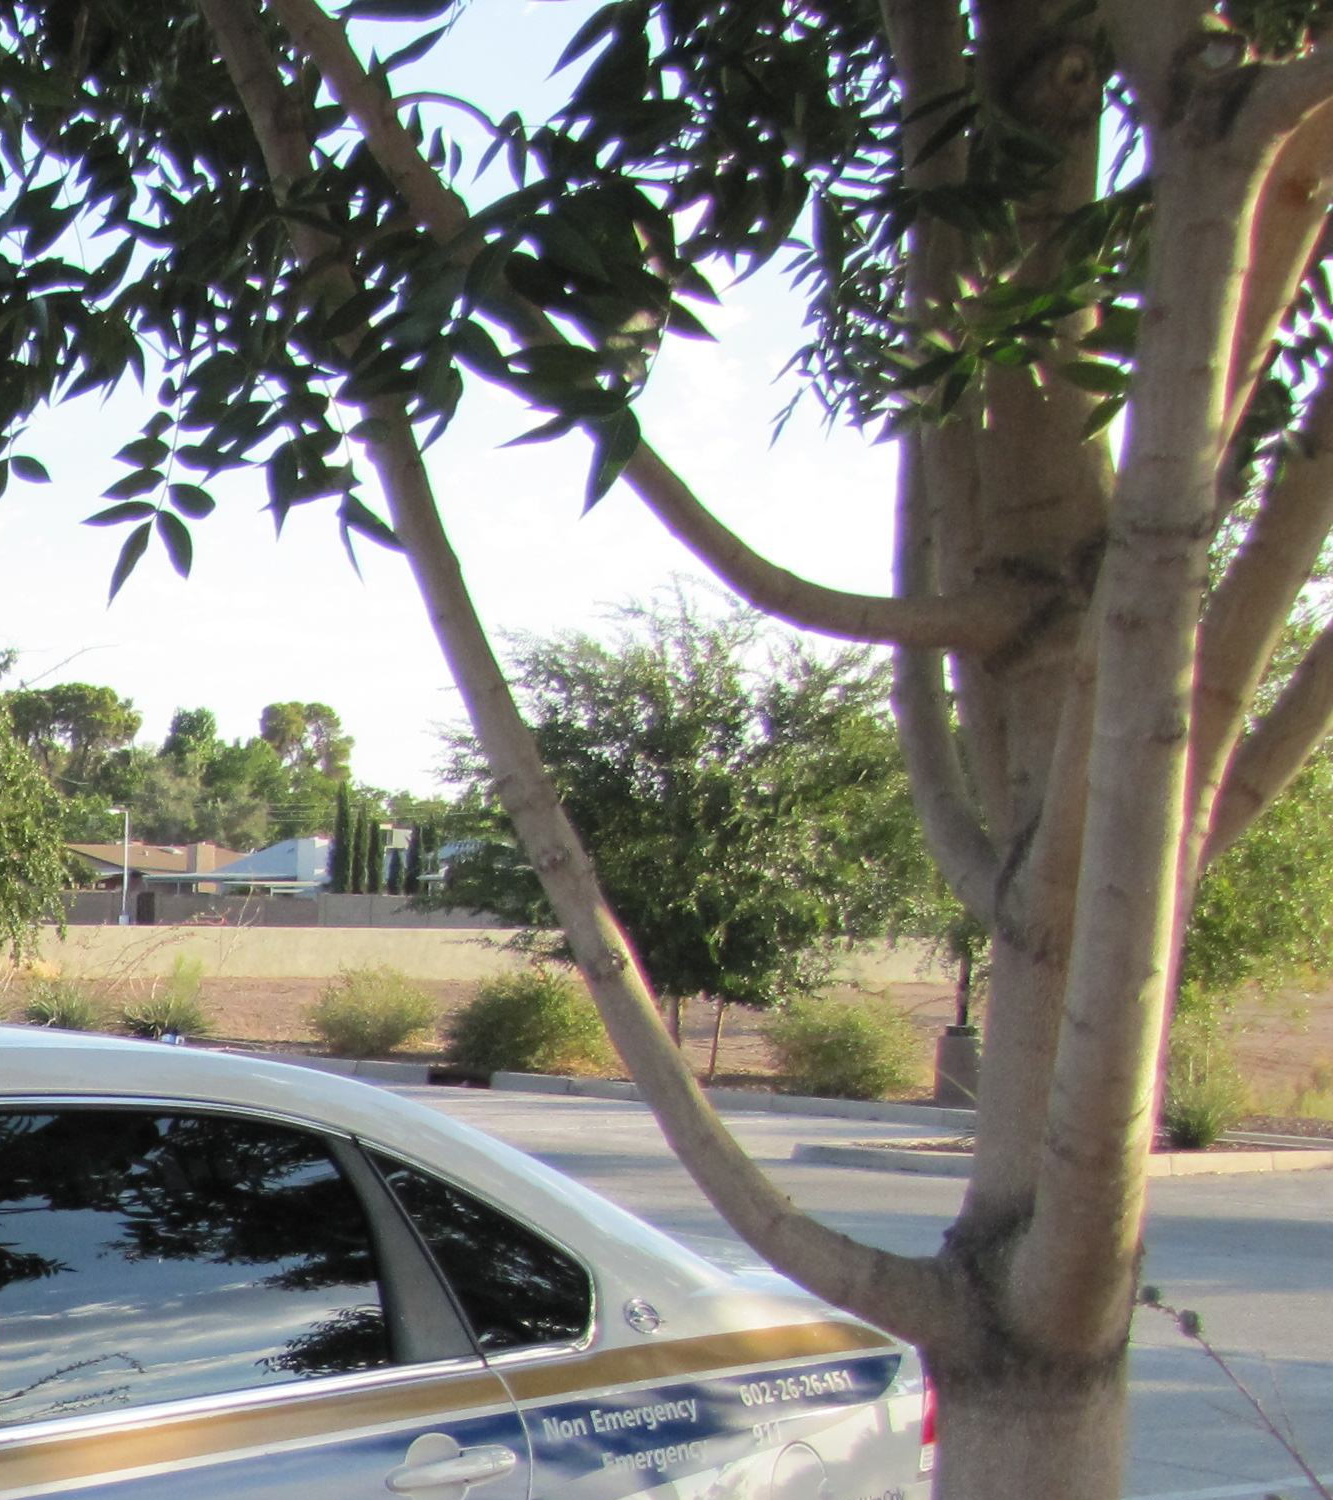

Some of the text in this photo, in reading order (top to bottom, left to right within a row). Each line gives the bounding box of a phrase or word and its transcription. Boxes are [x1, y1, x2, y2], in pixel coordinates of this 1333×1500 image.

[739, 1370, 853, 1406] 602-26-26-151
[542, 1399, 697, 1441] Non Emergency
[753, 1421, 781, 1446] 911
[601, 1440, 708, 1473] Emergency
